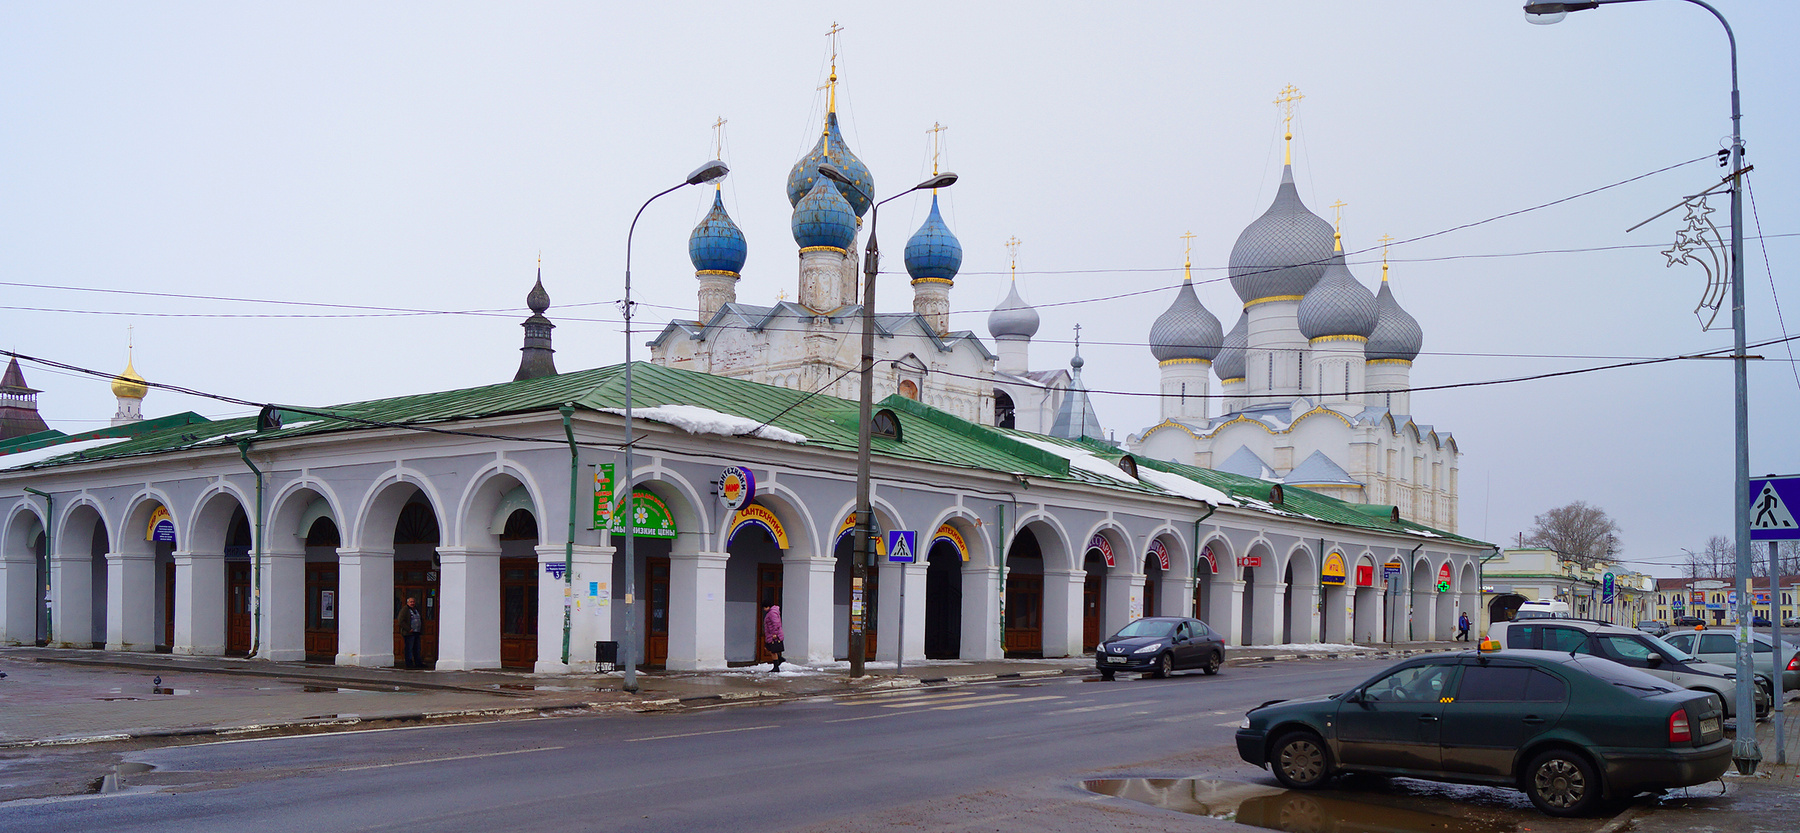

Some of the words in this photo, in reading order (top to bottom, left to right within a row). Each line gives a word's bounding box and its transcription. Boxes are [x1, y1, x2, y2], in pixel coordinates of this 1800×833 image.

[718, 467, 747, 491] САНТЕХНИКИ
[725, 483, 740, 492] МИР
[741, 507, 783, 538] САНТЕХНИКИ
[657, 528, 676, 537] ЦЕНЫ
